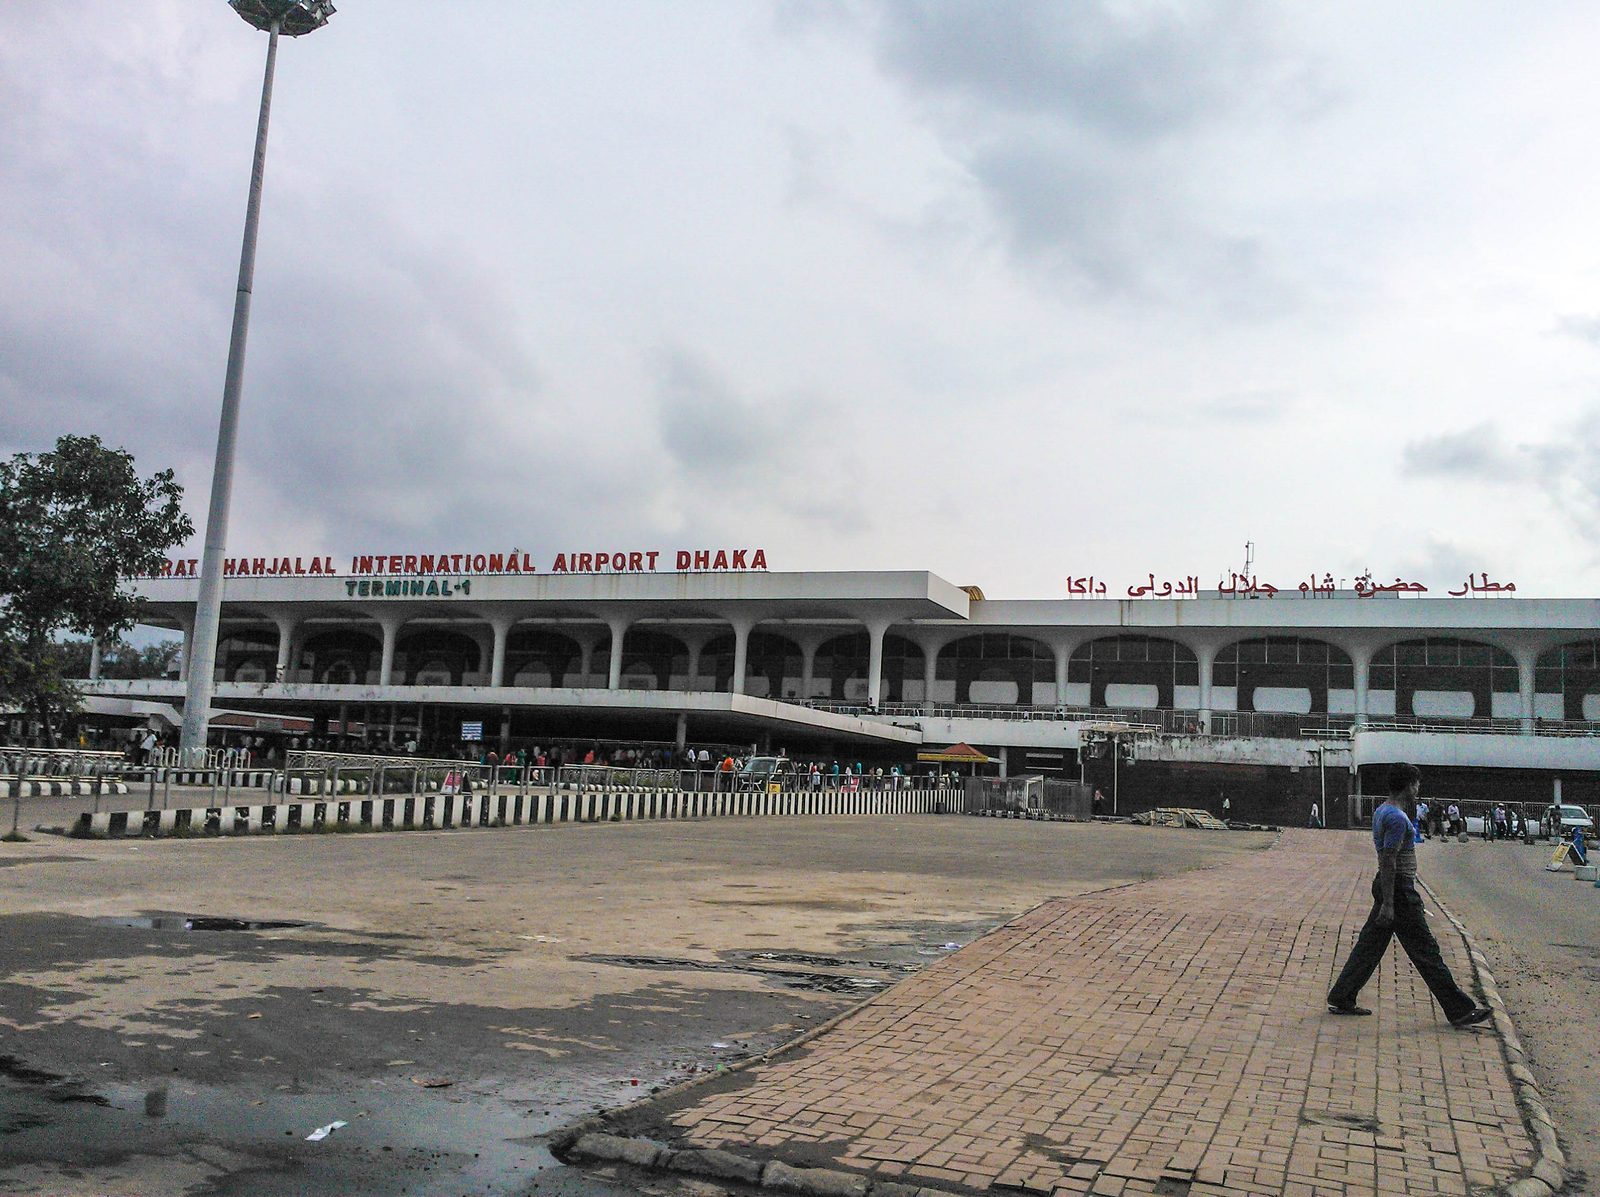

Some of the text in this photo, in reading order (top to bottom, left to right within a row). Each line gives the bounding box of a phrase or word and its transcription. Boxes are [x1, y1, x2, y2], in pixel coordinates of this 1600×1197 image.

[223, 557, 337, 575] HAHJALAL
[351, 553, 536, 574] INTERNATIONAL
[552, 551, 659, 572] AIRPORT
[676, 549, 768, 571] DHAKA
[345, 579, 471, 597] TERMINAL-1
[1066, 575, 1107, 594] داكا
[1218, 573, 1279, 599] جلال
[1298, 573, 1335, 593] شاه
[1354, 576, 1428, 598] حضرة
[1448, 572, 1517, 597] مطار
